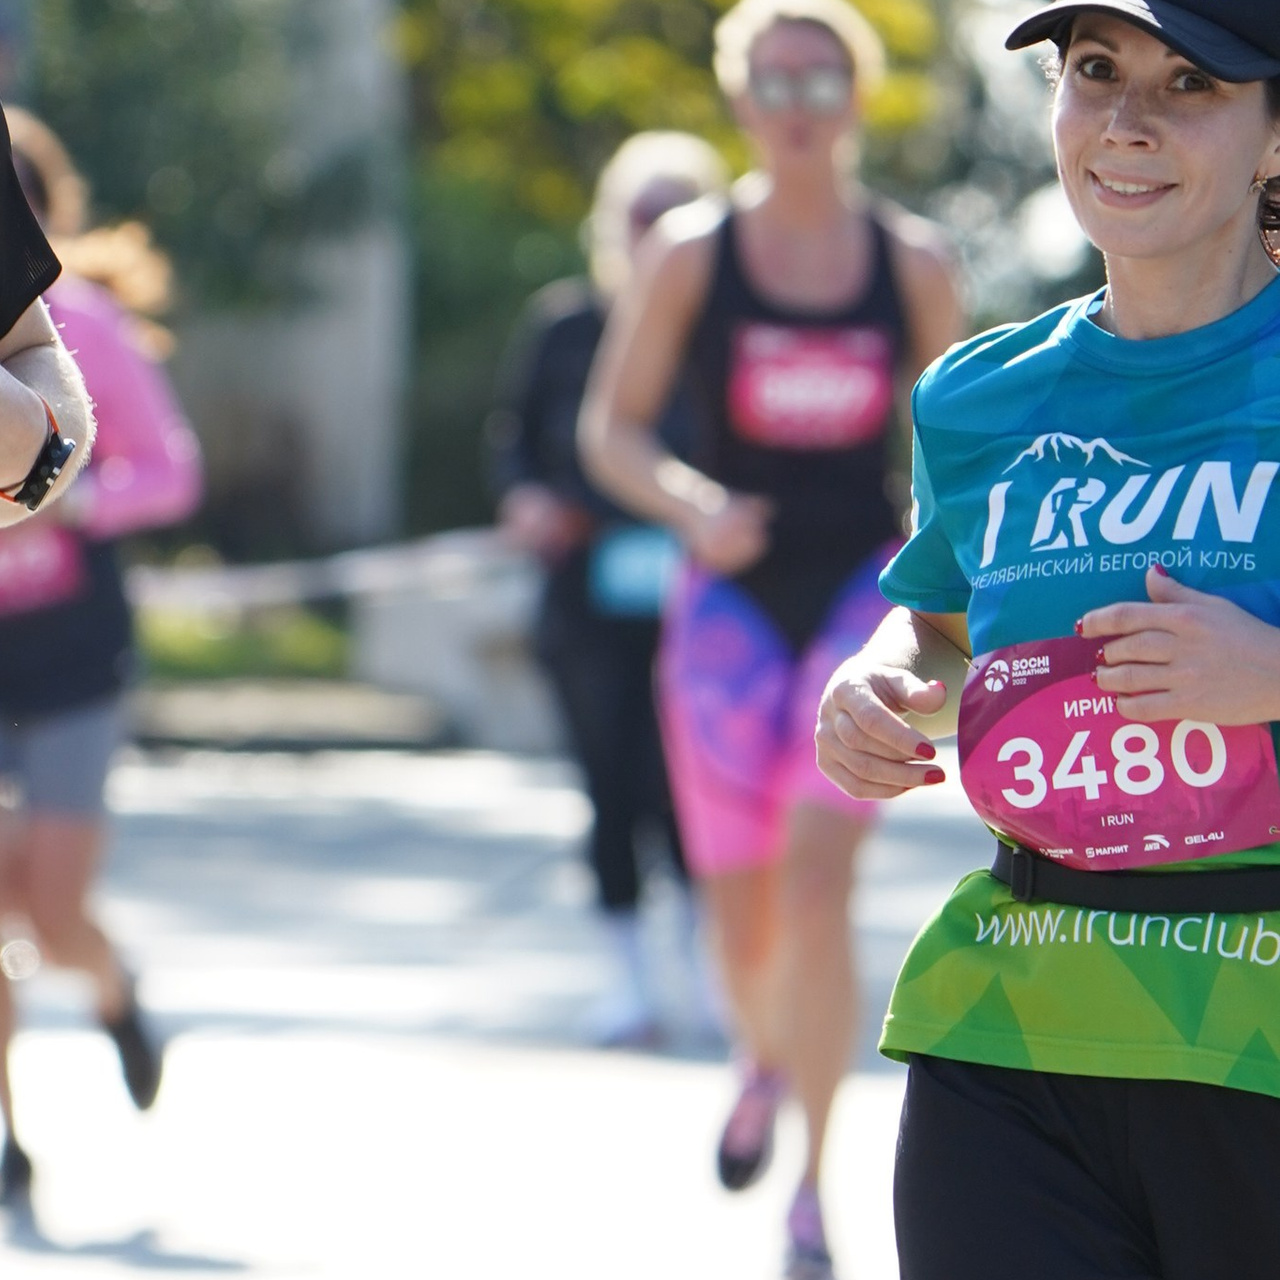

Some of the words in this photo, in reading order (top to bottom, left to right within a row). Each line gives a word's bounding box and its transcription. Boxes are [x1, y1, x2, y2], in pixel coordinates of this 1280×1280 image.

[979, 481, 1012, 568] I
[1030, 461, 1279, 552] RUN
[971, 553, 1094, 590] ЧЕЛЯБИНСКИЙ
[1100, 547, 1192, 572] БЕГОВОЙ
[1199, 550, 1256, 571] КЛУБ
[1012, 656, 1050, 671] SOCHI
[1012, 667, 1050, 678] MARATHON
[1012, 678, 1027, 686] 2022
[997, 720, 1226, 809] 3480
[1107, 813, 1135, 826] RUN
[1095, 844, 1129, 856] МАГНИТ
